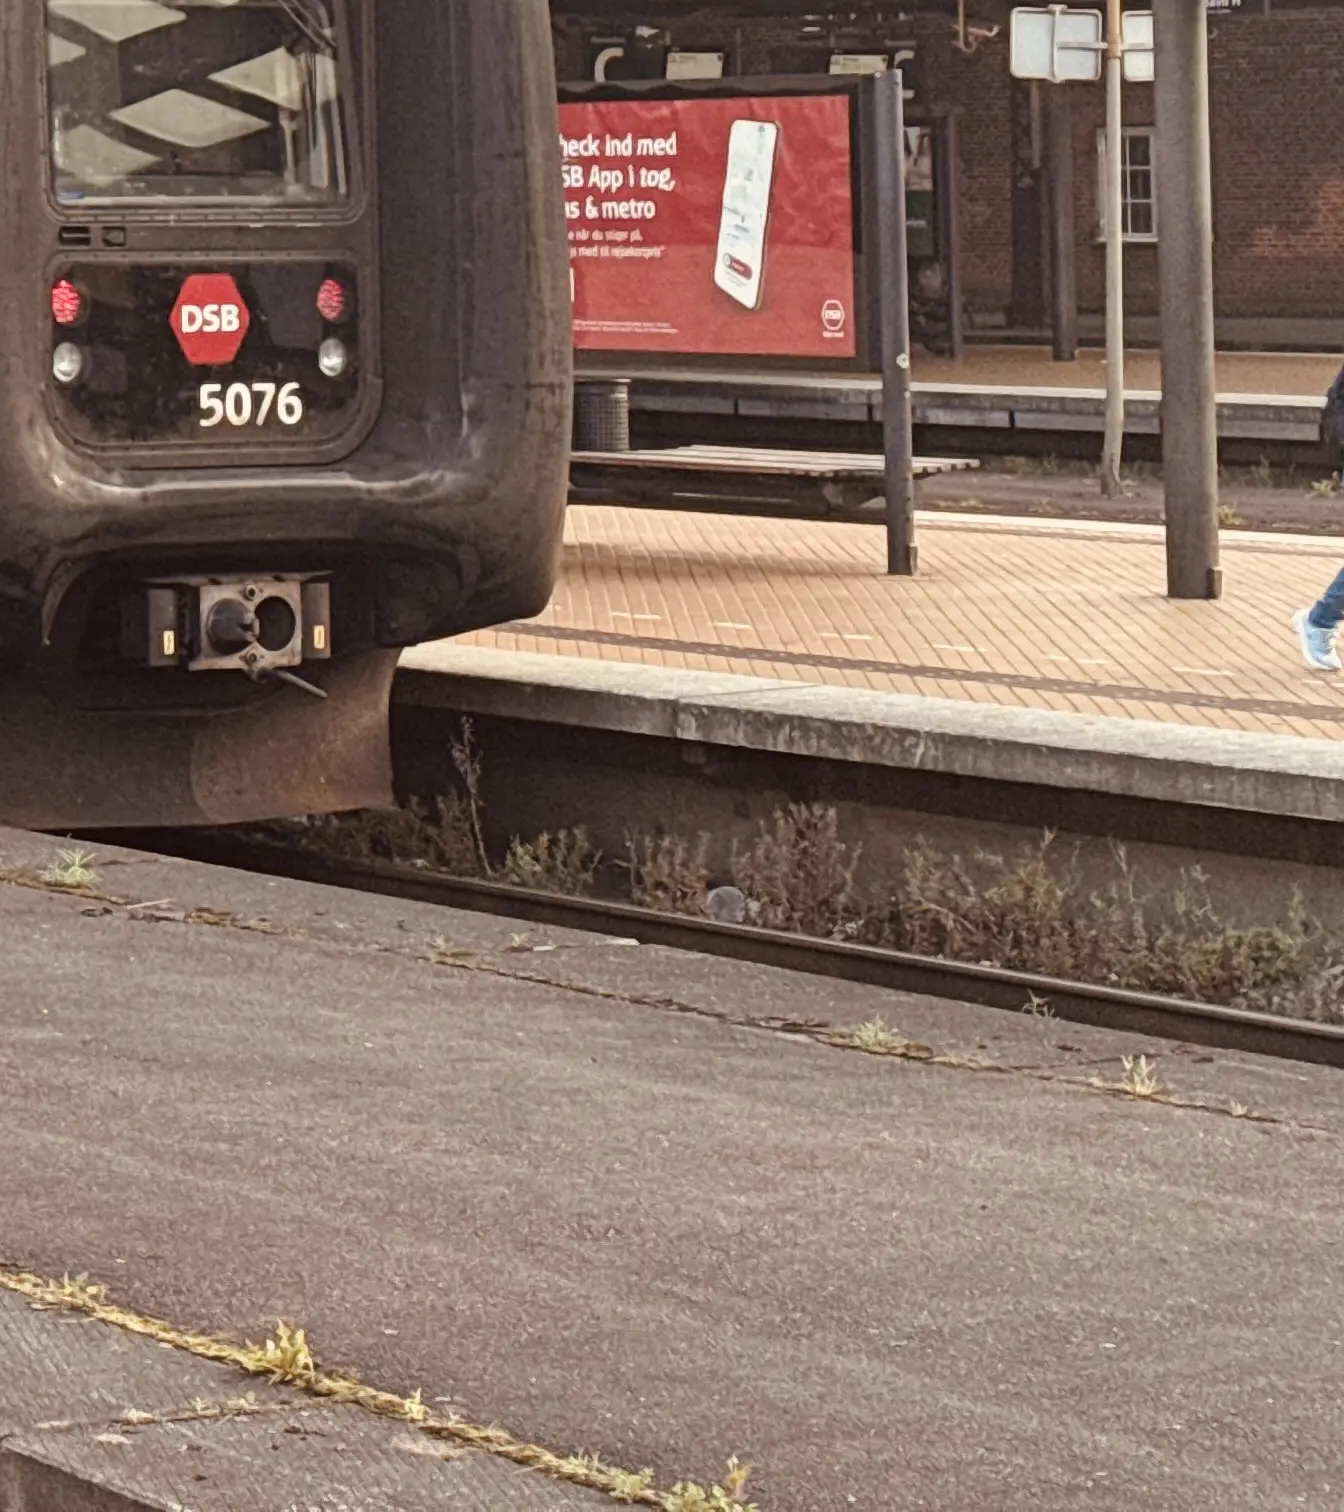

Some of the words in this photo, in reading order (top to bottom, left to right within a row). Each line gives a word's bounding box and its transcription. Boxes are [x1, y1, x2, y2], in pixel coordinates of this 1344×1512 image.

[636, 130, 678, 157] med
[587, 164, 624, 195] App
[628, 164, 634, 188] i
[639, 166, 677, 193] tog,
[585, 194, 600, 220] &
[601, 197, 657, 220] metro
[180, 303, 241, 334] DSB
[198, 381, 305, 429] 5076
